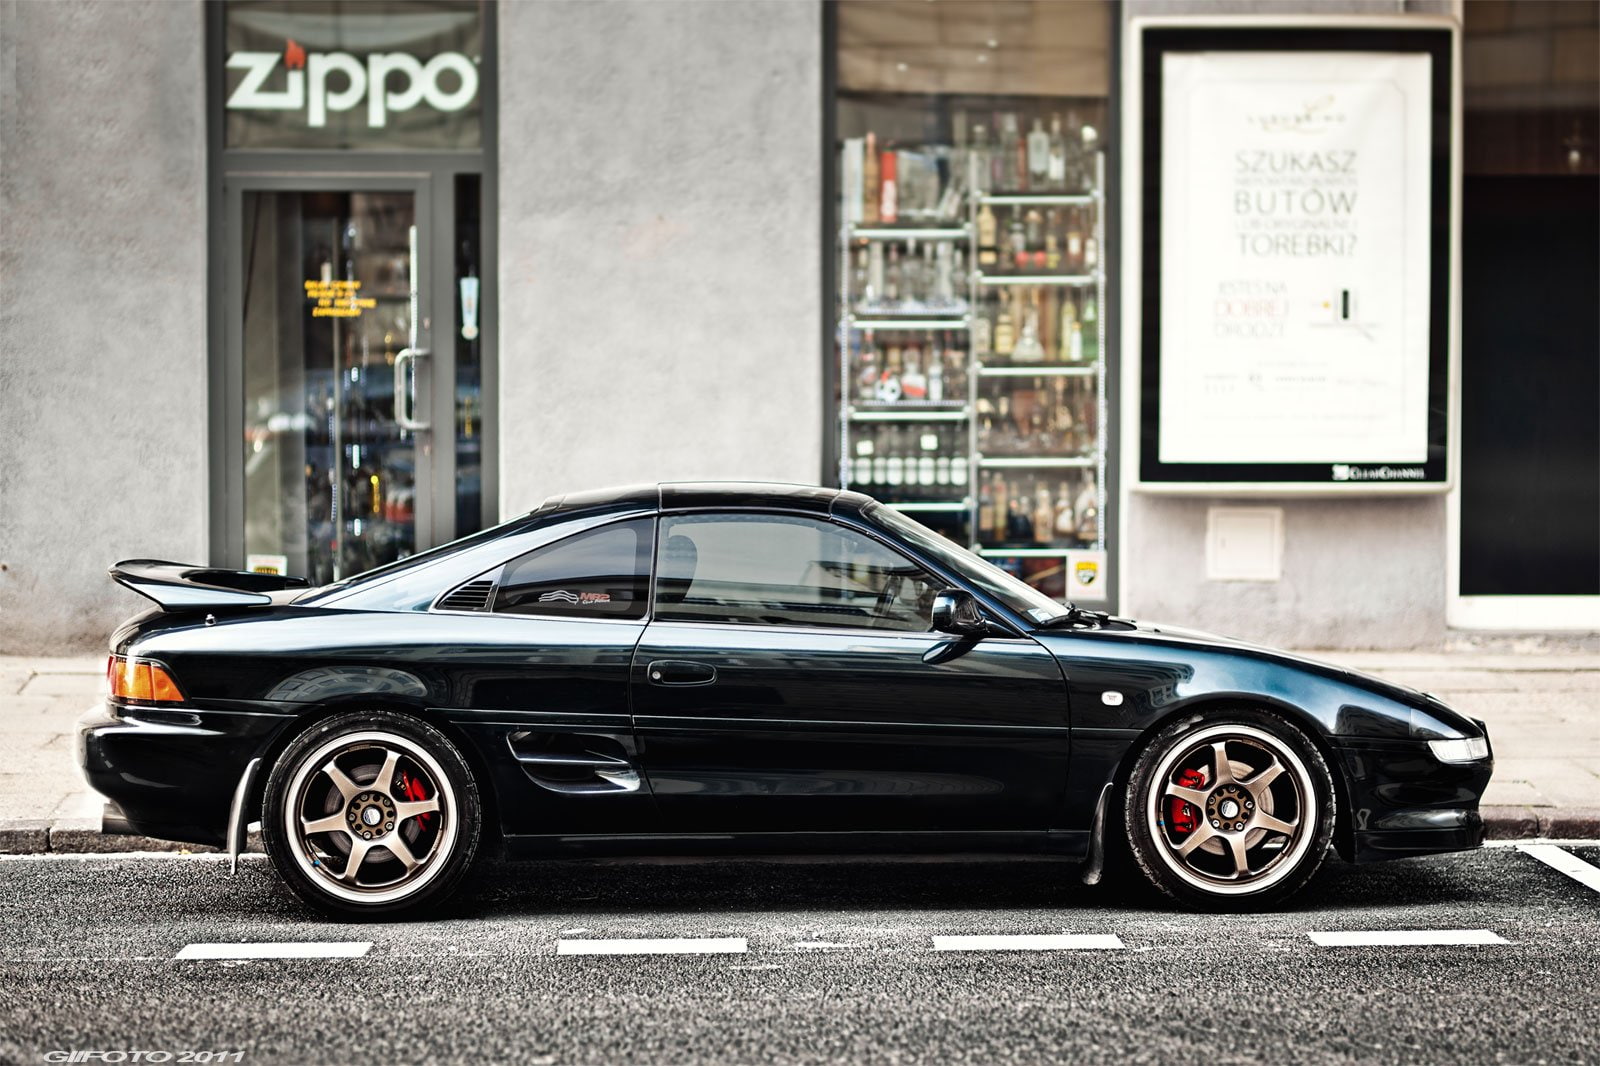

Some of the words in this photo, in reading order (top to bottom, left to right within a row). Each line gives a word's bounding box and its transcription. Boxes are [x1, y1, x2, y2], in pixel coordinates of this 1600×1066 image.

[1235, 149, 1357, 173] SZUKASZ
[1234, 184, 1358, 215] BUTÓW
[1236, 232, 1358, 256] TOREBKI?
[580, 592, 610, 600] MR2
